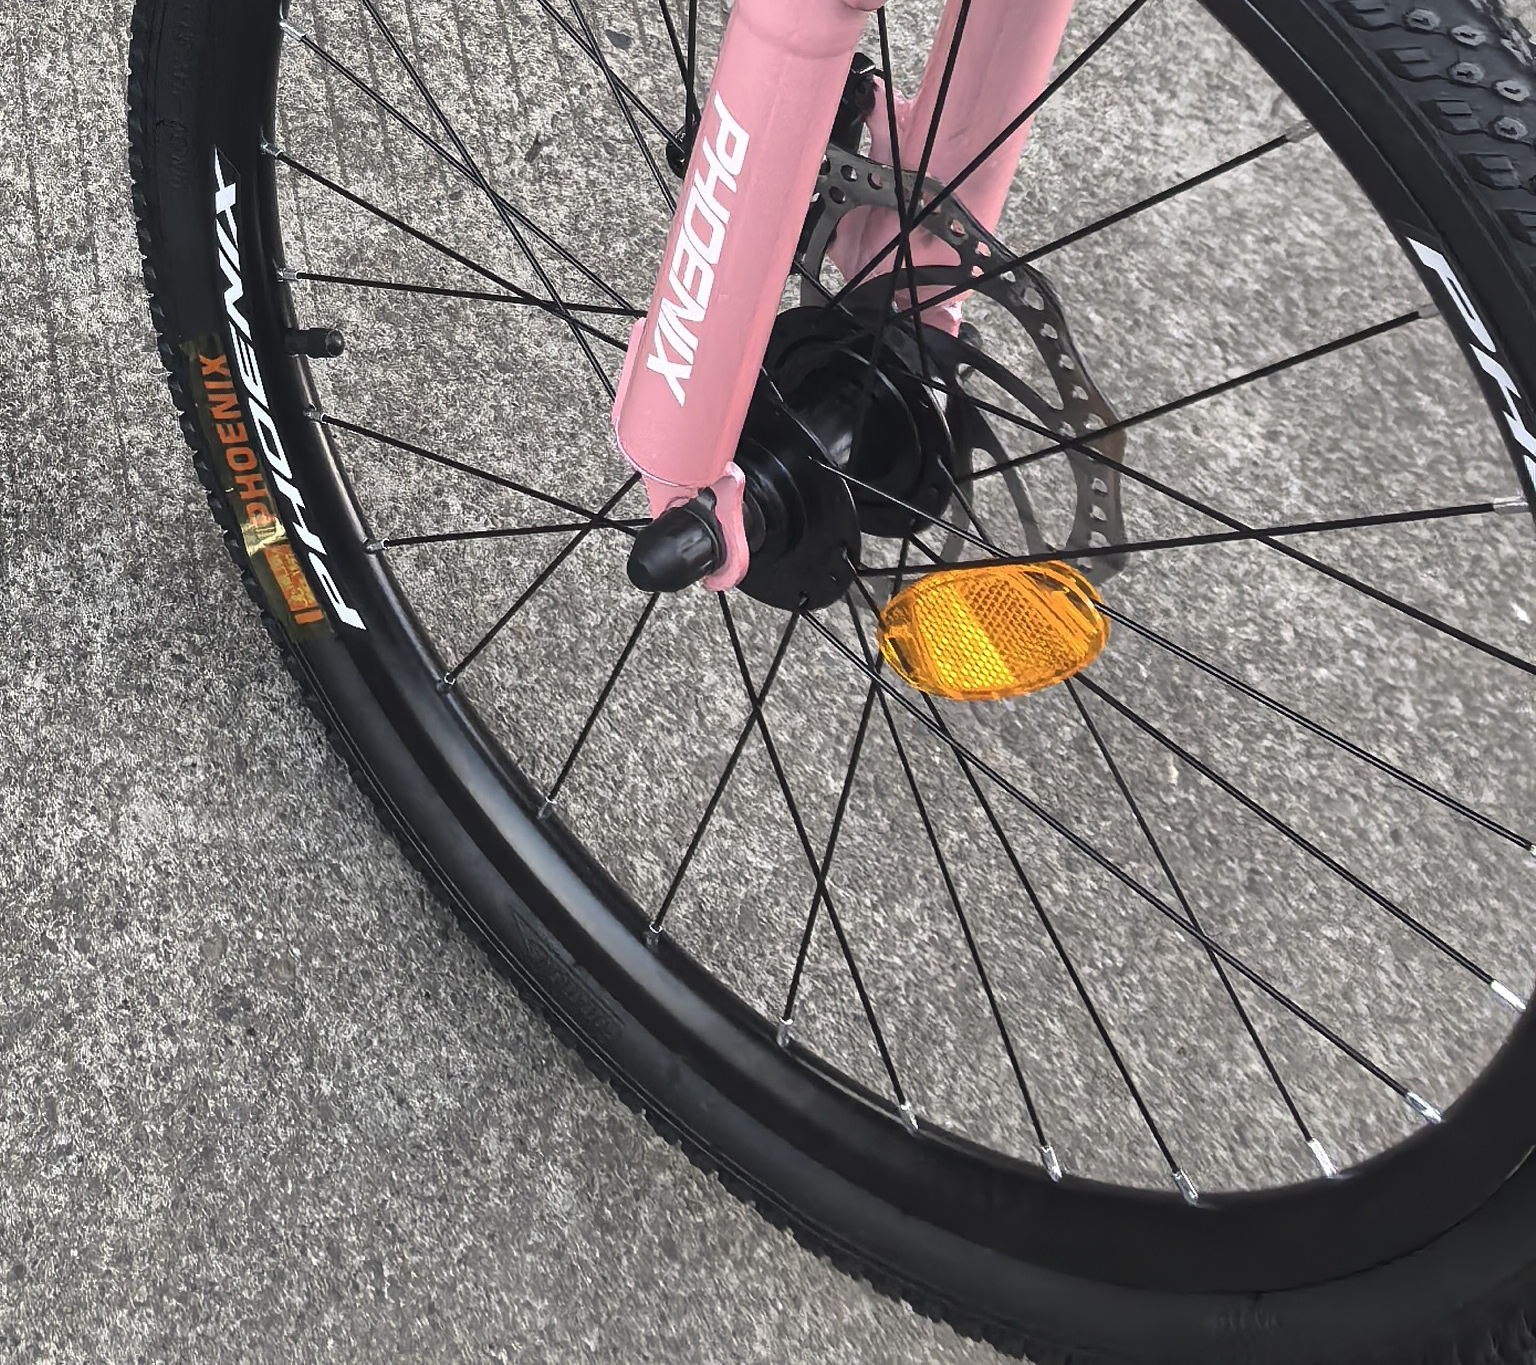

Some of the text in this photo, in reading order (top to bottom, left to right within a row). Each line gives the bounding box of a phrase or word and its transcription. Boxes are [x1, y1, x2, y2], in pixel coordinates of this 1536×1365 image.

[214, 144, 366, 630] PHOENIX
[647, 91, 750, 407] PHOENIX
[1407, 235, 1536, 497] PH
[199, 354, 278, 531] PHOENIX
